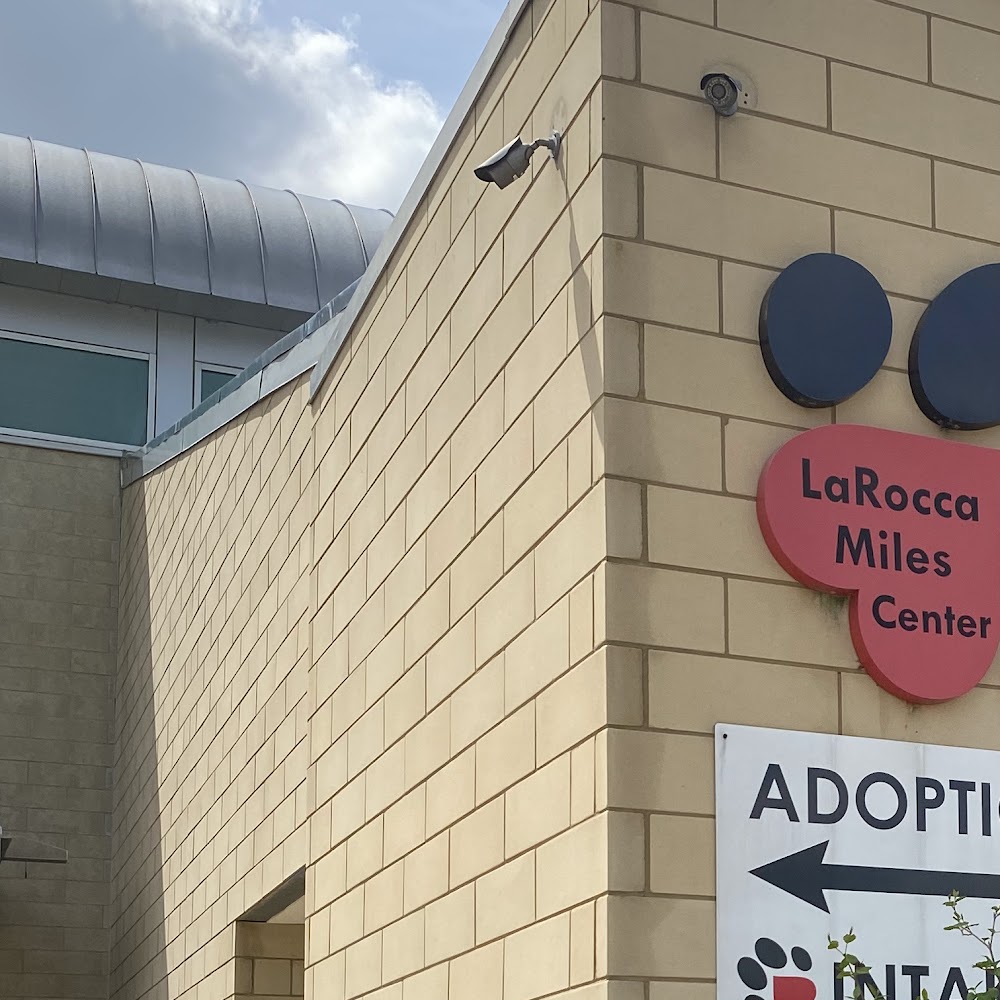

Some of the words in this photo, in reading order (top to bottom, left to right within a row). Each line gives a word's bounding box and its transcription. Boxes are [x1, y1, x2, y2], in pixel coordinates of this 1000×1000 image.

[801, 457, 979, 522] LaRocca
[835, 525, 952, 577] Miles
[872, 594, 992, 639] Center
